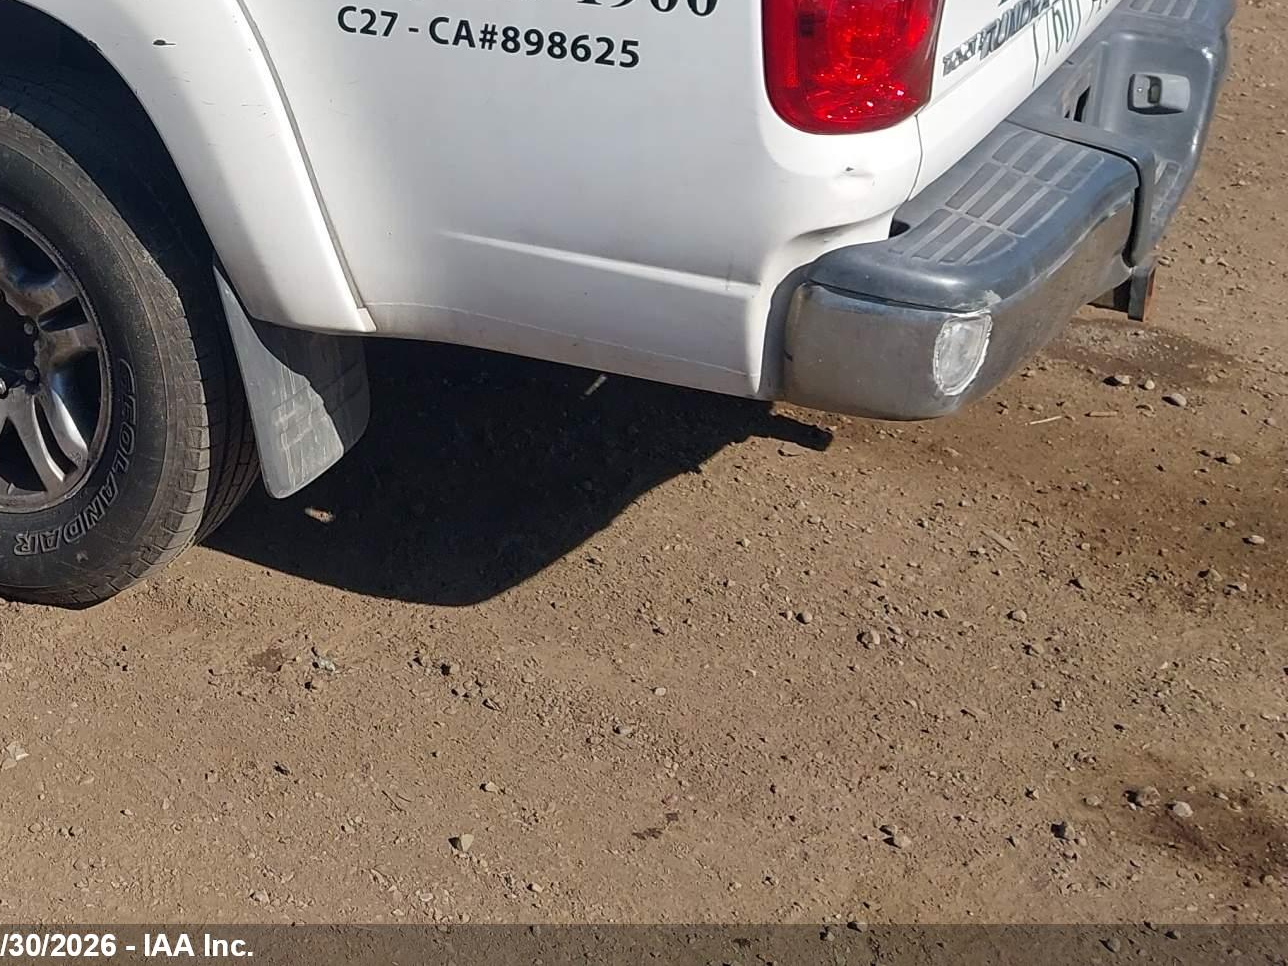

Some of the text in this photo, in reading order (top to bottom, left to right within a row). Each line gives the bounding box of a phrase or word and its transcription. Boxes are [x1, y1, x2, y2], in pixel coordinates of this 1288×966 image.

[337, 5, 399, 37] C27
[428, 16, 640, 69] CA#898625
[12, 356, 138, 557] GEOLANDAR
